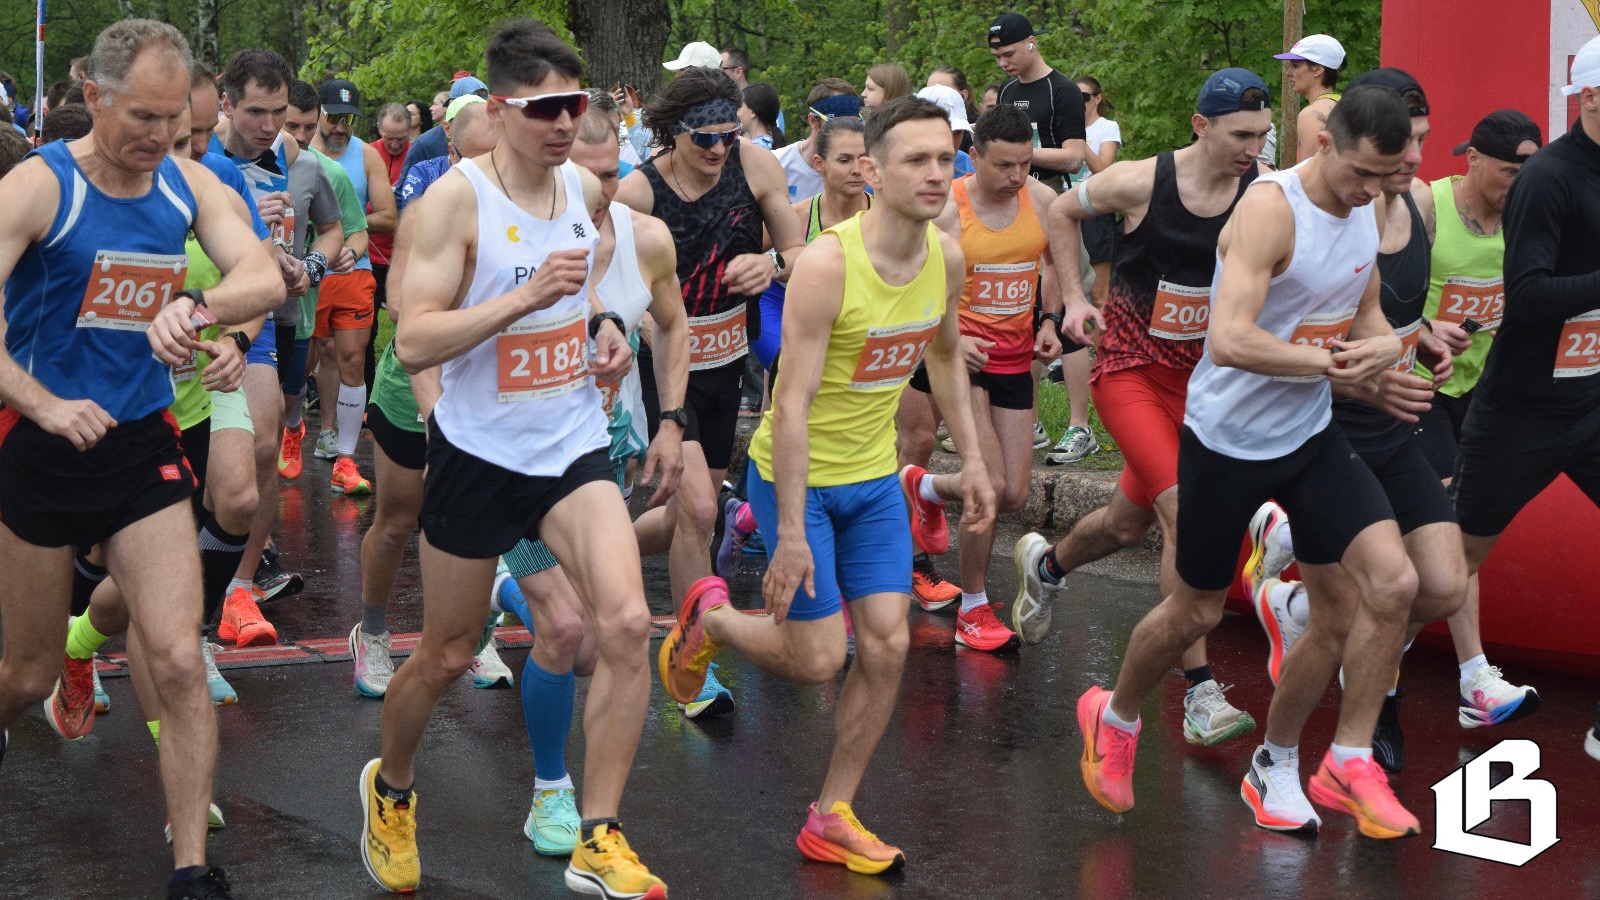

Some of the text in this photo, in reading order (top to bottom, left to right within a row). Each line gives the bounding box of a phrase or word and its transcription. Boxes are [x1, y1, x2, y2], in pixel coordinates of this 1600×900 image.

[515, 266, 537, 285] PA
[93, 278, 172, 308] 2061
[978, 279, 1029, 299] 2169
[118, 308, 142, 318] Игорь
[1161, 302, 1209, 325] 200
[1447, 293, 1504, 316] 2275
[689, 323, 741, 354] 2205
[1565, 332, 1600, 357] 22
[510, 337, 581, 378] 2182
[865, 340, 927, 371] 2321
[533, 373, 571, 386] Александр
